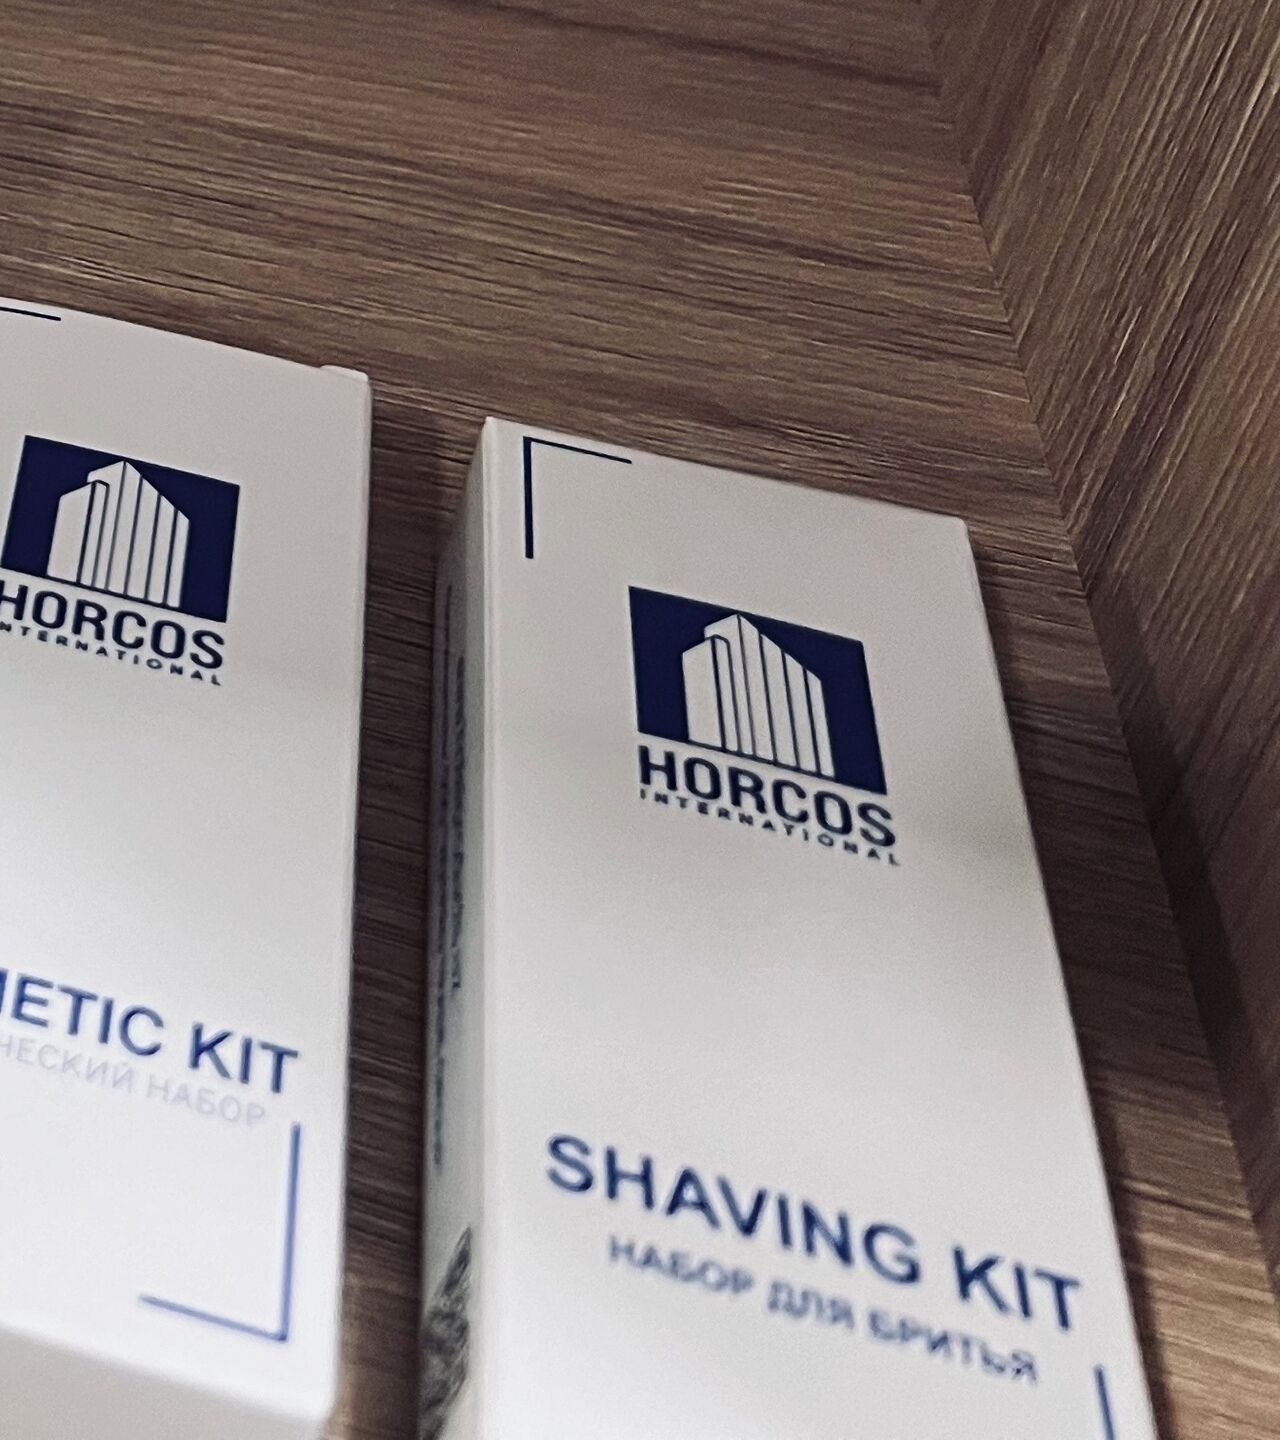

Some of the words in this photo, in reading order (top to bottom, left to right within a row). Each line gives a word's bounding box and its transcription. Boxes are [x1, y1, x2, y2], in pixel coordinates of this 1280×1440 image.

[638, 745, 896, 847] HORCOS
[639, 788, 900, 866] INTERNATIONAL
[147, 1074, 266, 1127] НАБОР
[188, 1021, 299, 1094] KIT
[546, 1134, 922, 1286] SHAVING
[953, 1245, 1080, 1331] KIT
[609, 1235, 754, 1296] НАБОР
[768, 1280, 855, 1329] ДЛЯ
[868, 1310, 1038, 1384] БРИТЬЯ
